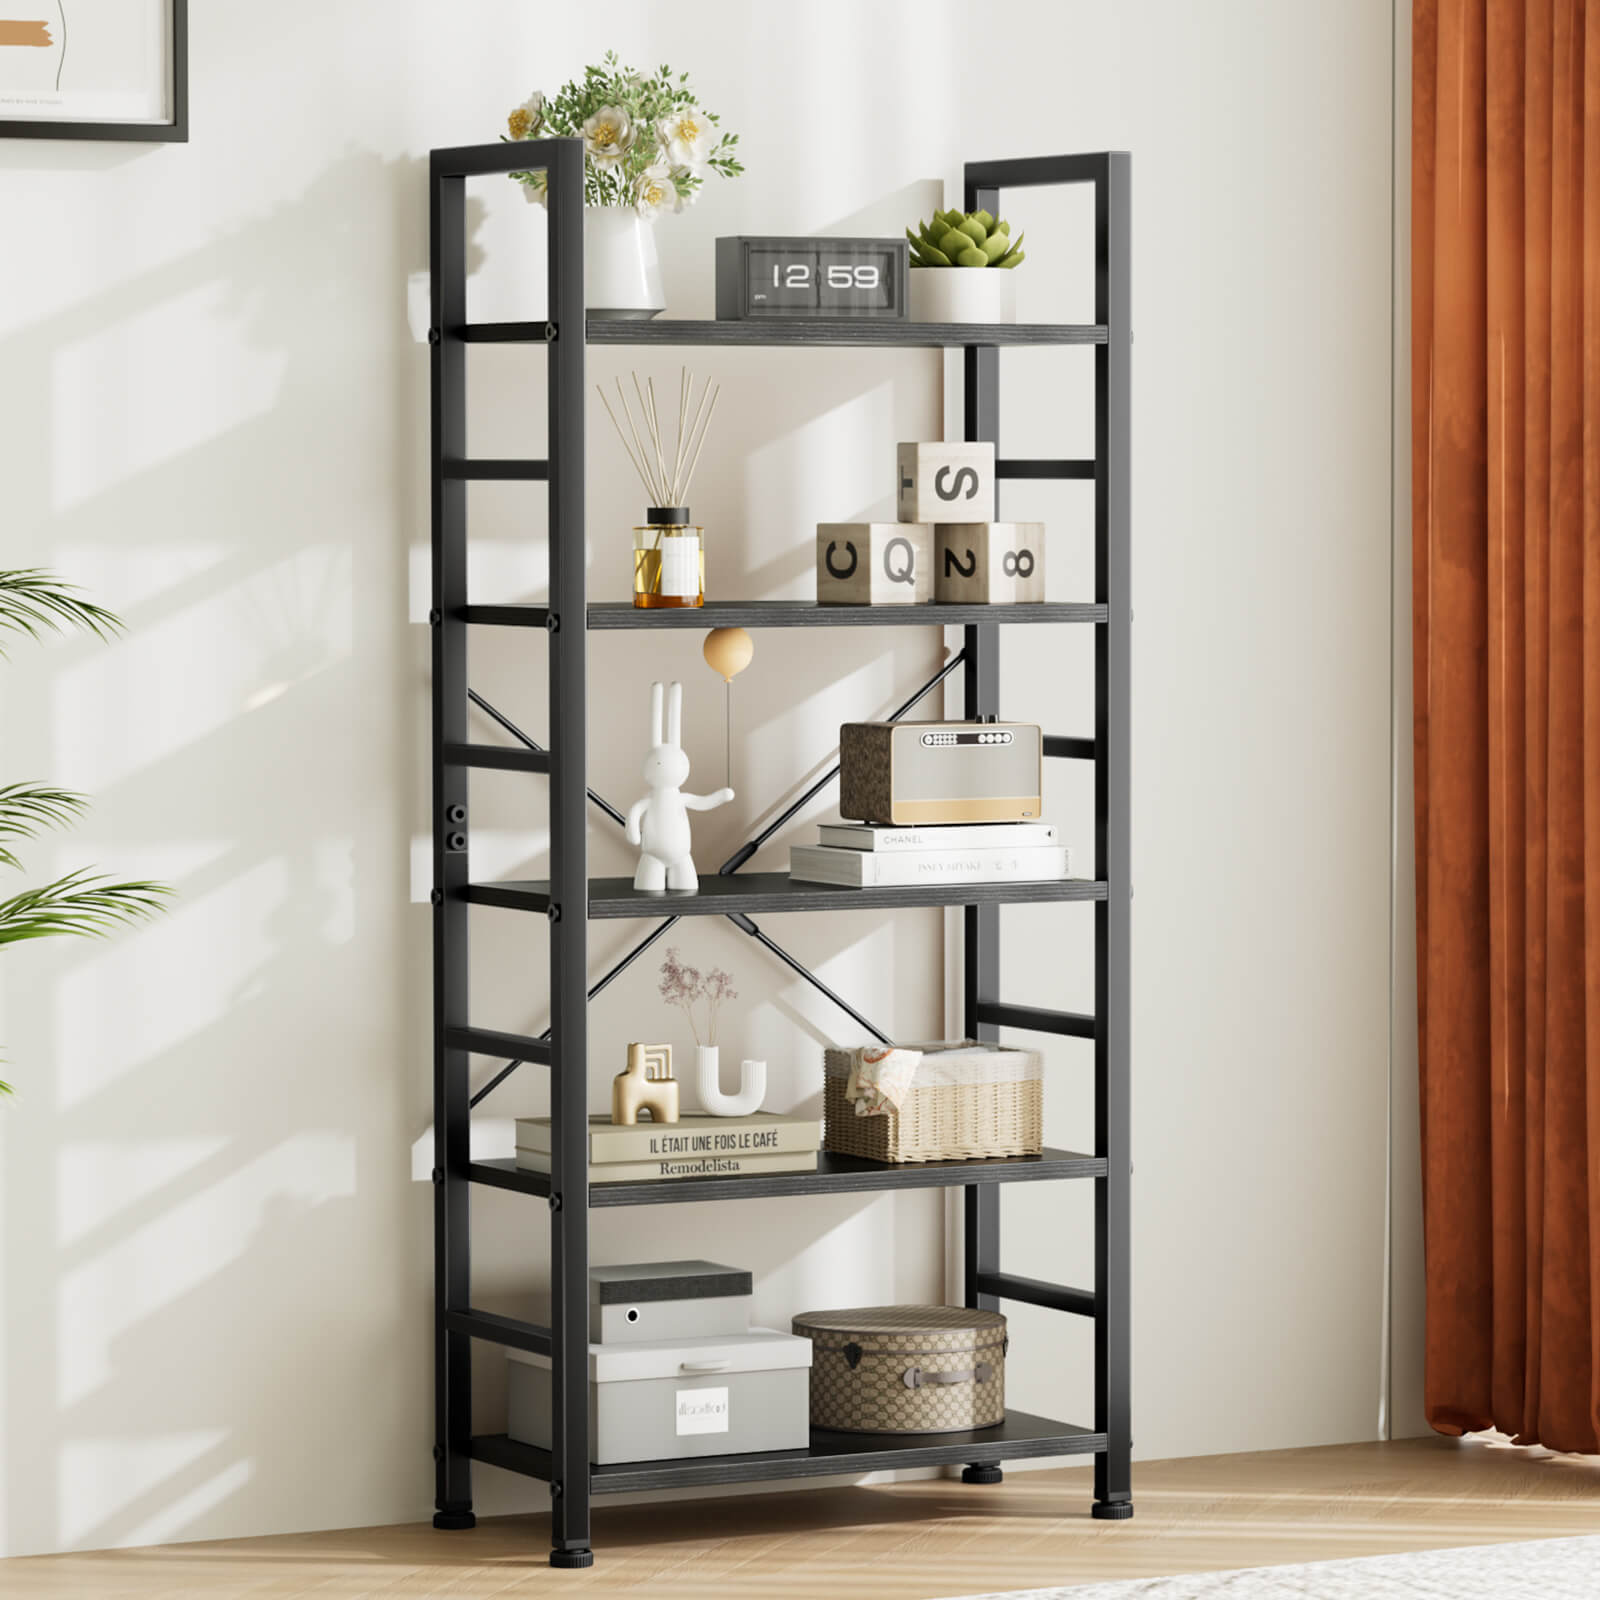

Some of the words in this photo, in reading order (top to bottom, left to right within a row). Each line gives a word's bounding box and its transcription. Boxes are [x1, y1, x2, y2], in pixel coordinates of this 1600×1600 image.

[773, 264, 810, 288] 12
[827, 265, 880, 289] 59
[935, 465, 979, 502] S
[825, 540, 858, 580] C
[883, 537, 916, 586] Q
[944, 547, 977, 578] 2
[1002, 548, 1036, 579] 8
[883, 835, 924, 845] CHANEL
[649, 1138, 659, 1154] IL
[661, 1135, 689, 1153] ÉTAIT
[692, 1136, 712, 1151] UNE
[714, 1134, 736, 1150] FOIS
[738, 1133, 751, 1149] LE
[753, 1130, 779, 1148] CAFÉ
[660, 1158, 740, 1175] Remodelista
